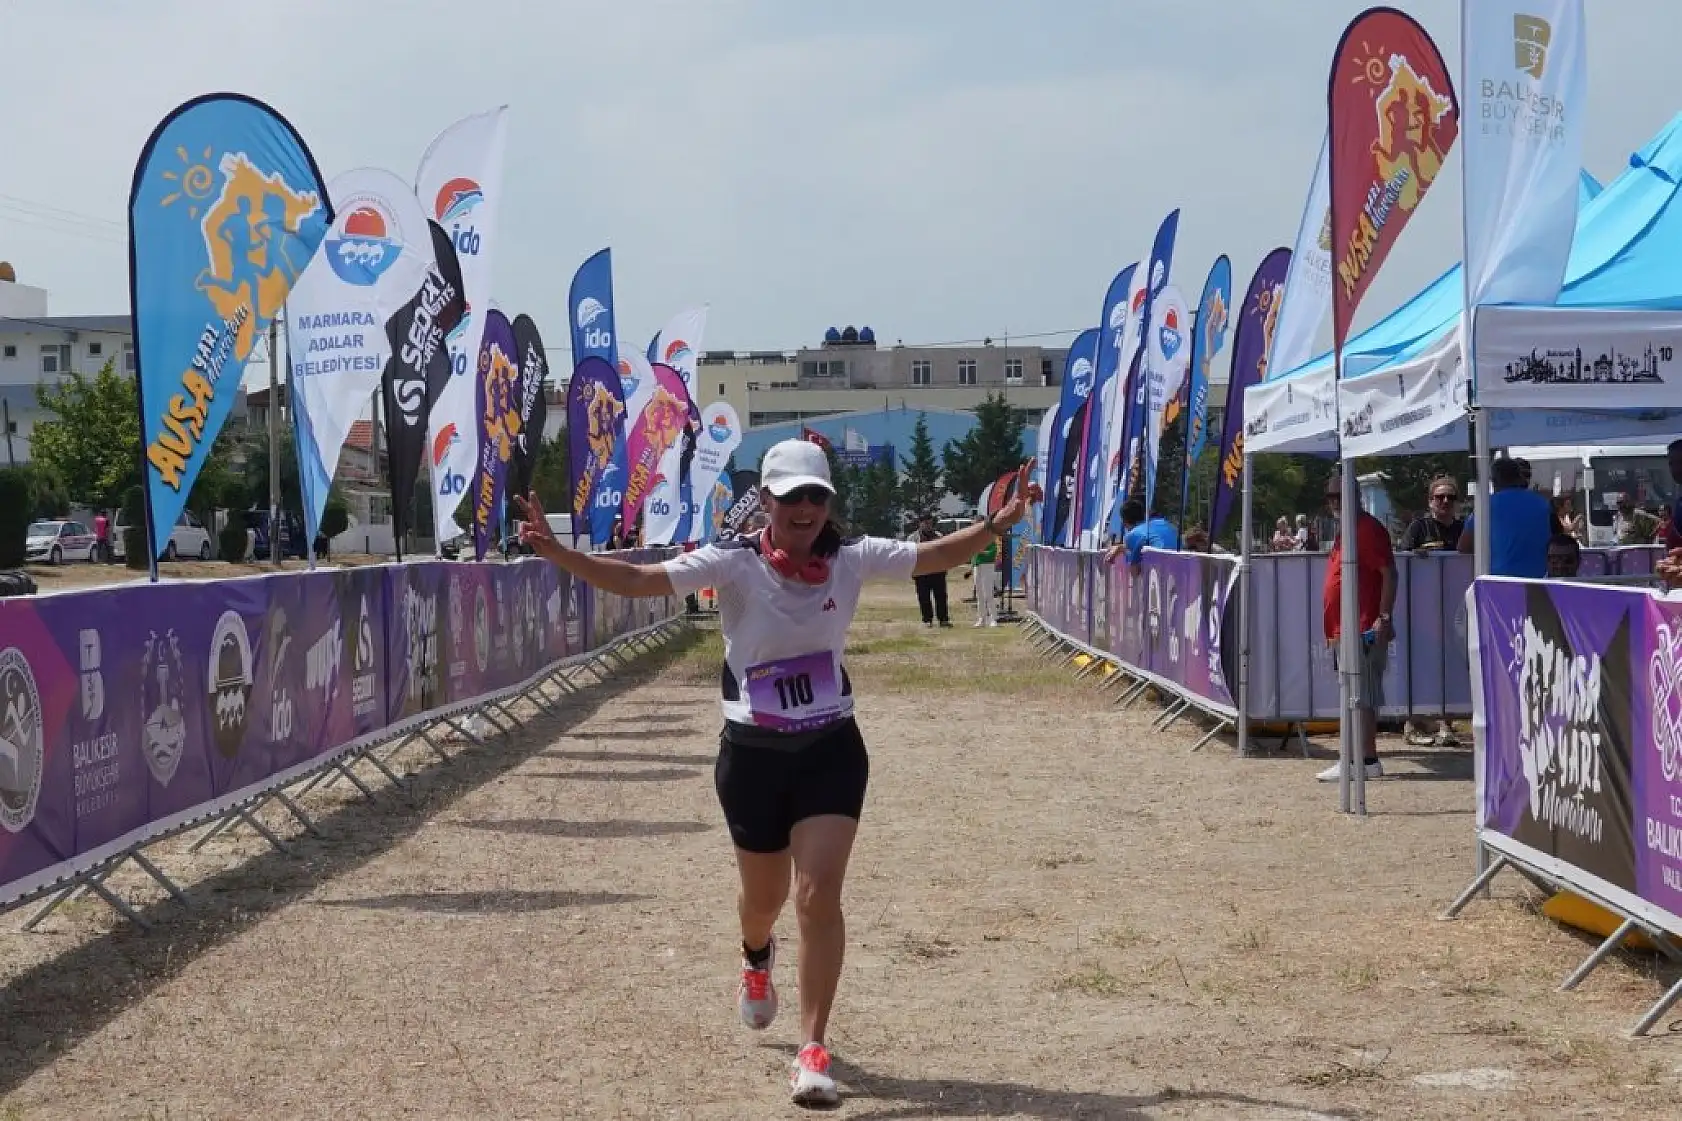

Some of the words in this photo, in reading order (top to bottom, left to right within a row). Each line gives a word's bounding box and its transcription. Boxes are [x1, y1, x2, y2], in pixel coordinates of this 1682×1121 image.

[453, 223, 480, 255] ido
[298, 311, 375, 331] MARMARA
[308, 334, 364, 352] ADALAR
[584, 328, 610, 349] ido
[1659, 347, 1673, 361] 10
[295, 353, 380, 378] BELEDİYESİ
[595, 486, 621, 508] ido
[650, 498, 670, 516] ido
[774, 673, 814, 709] 110
